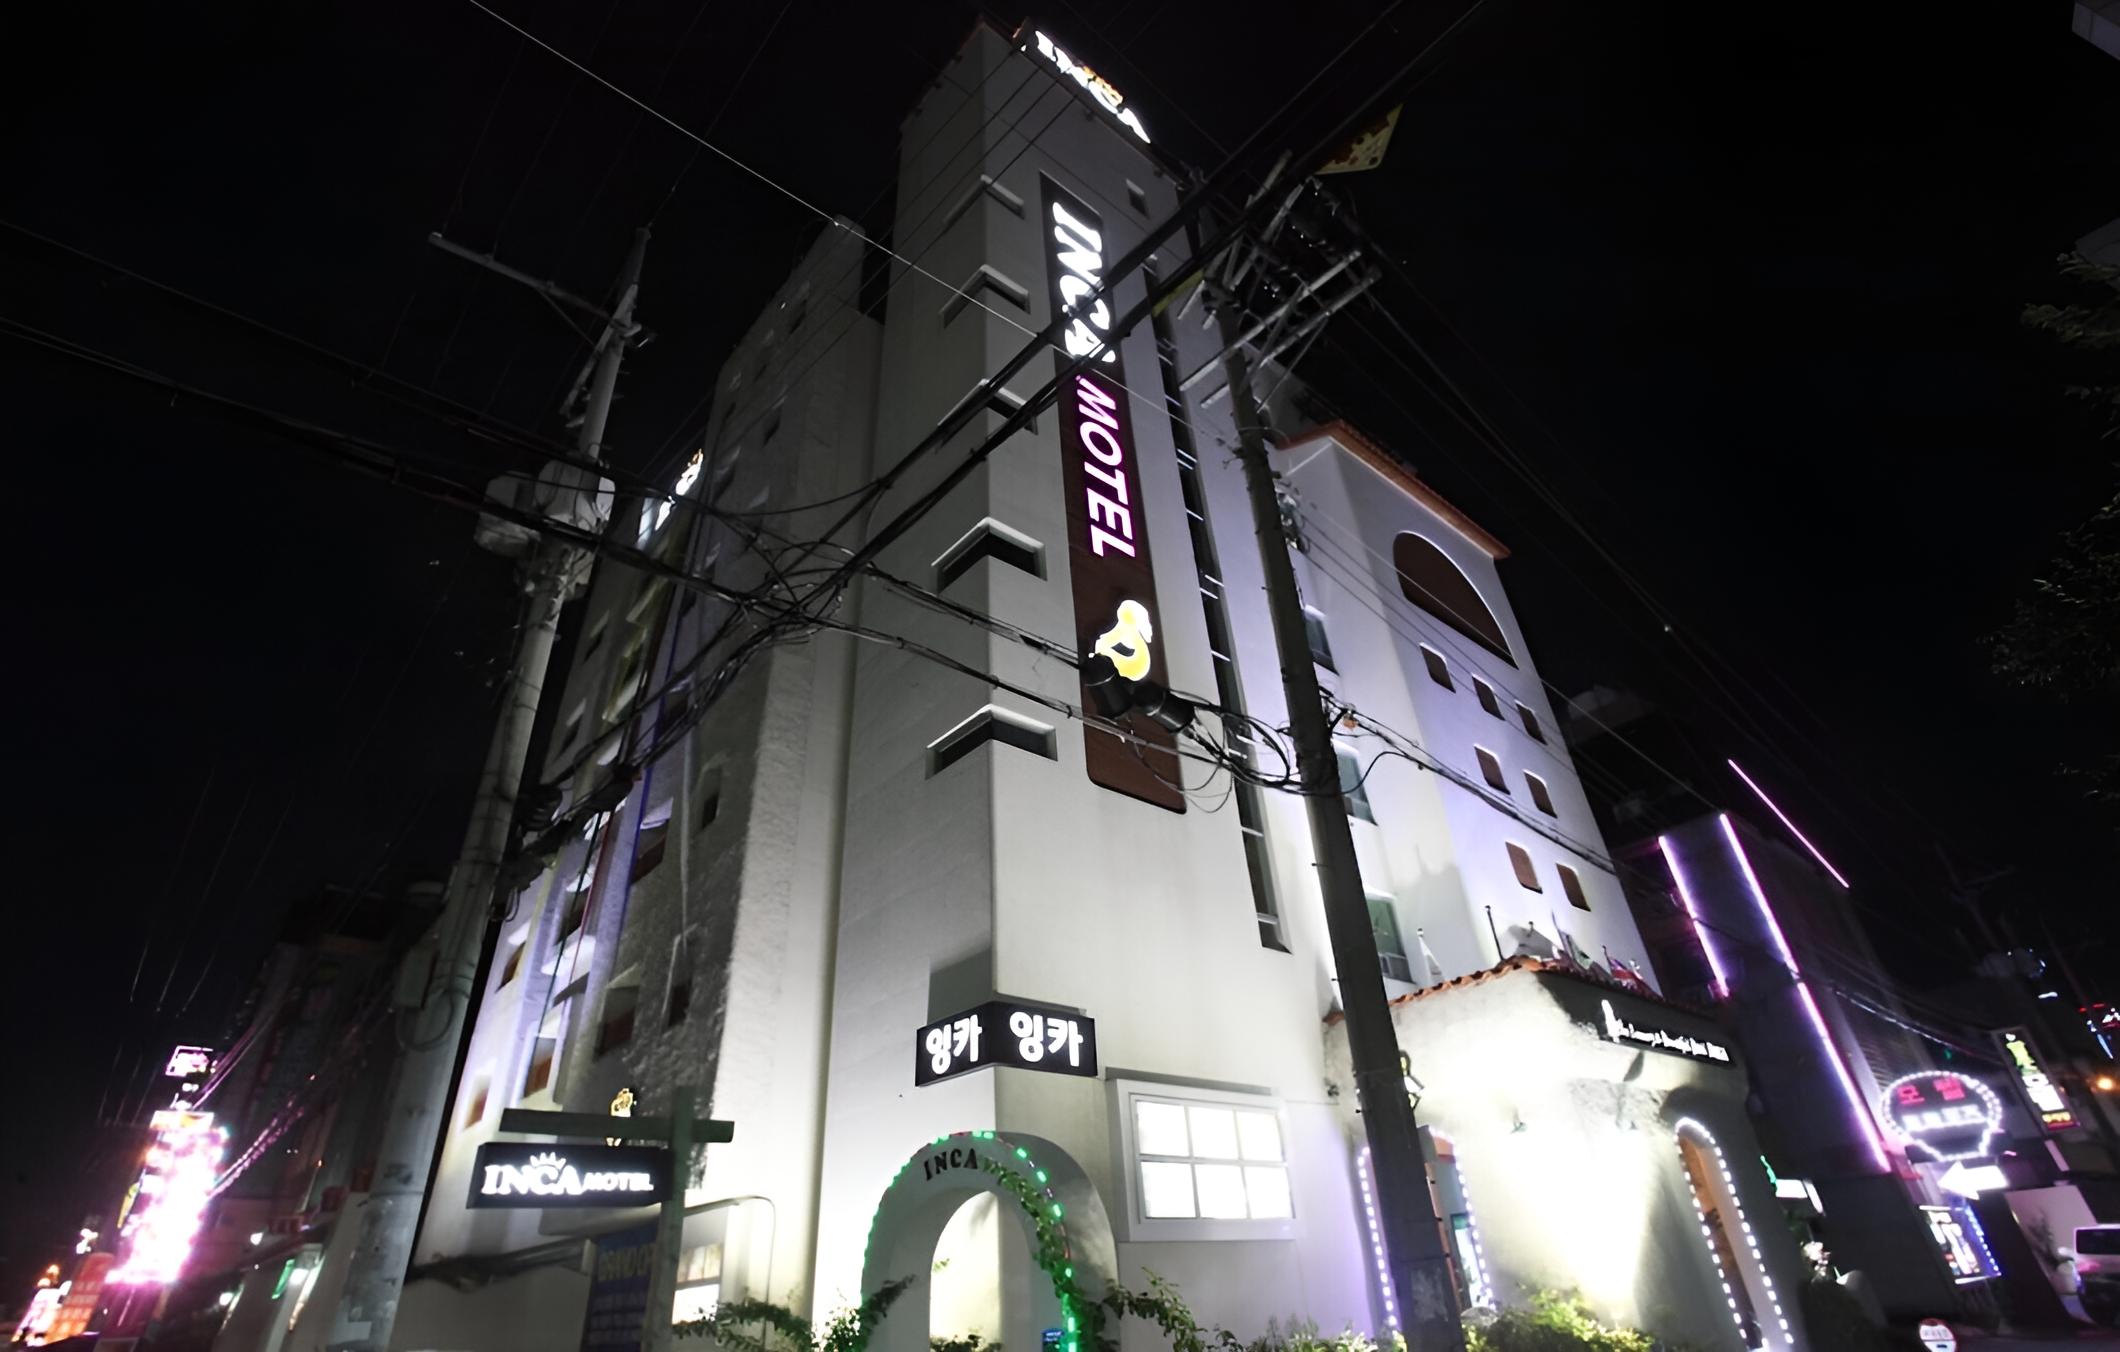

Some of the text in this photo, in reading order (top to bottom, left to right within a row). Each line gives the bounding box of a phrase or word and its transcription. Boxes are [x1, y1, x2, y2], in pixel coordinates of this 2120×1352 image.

[1075, 375, 1136, 558] MOTEL
[926, 1014, 983, 1075] 잉카
[1009, 1011, 1084, 1067] 잉카
[481, 1163, 654, 1195] INCA MOTEL
[923, 1147, 979, 1182] INCA
